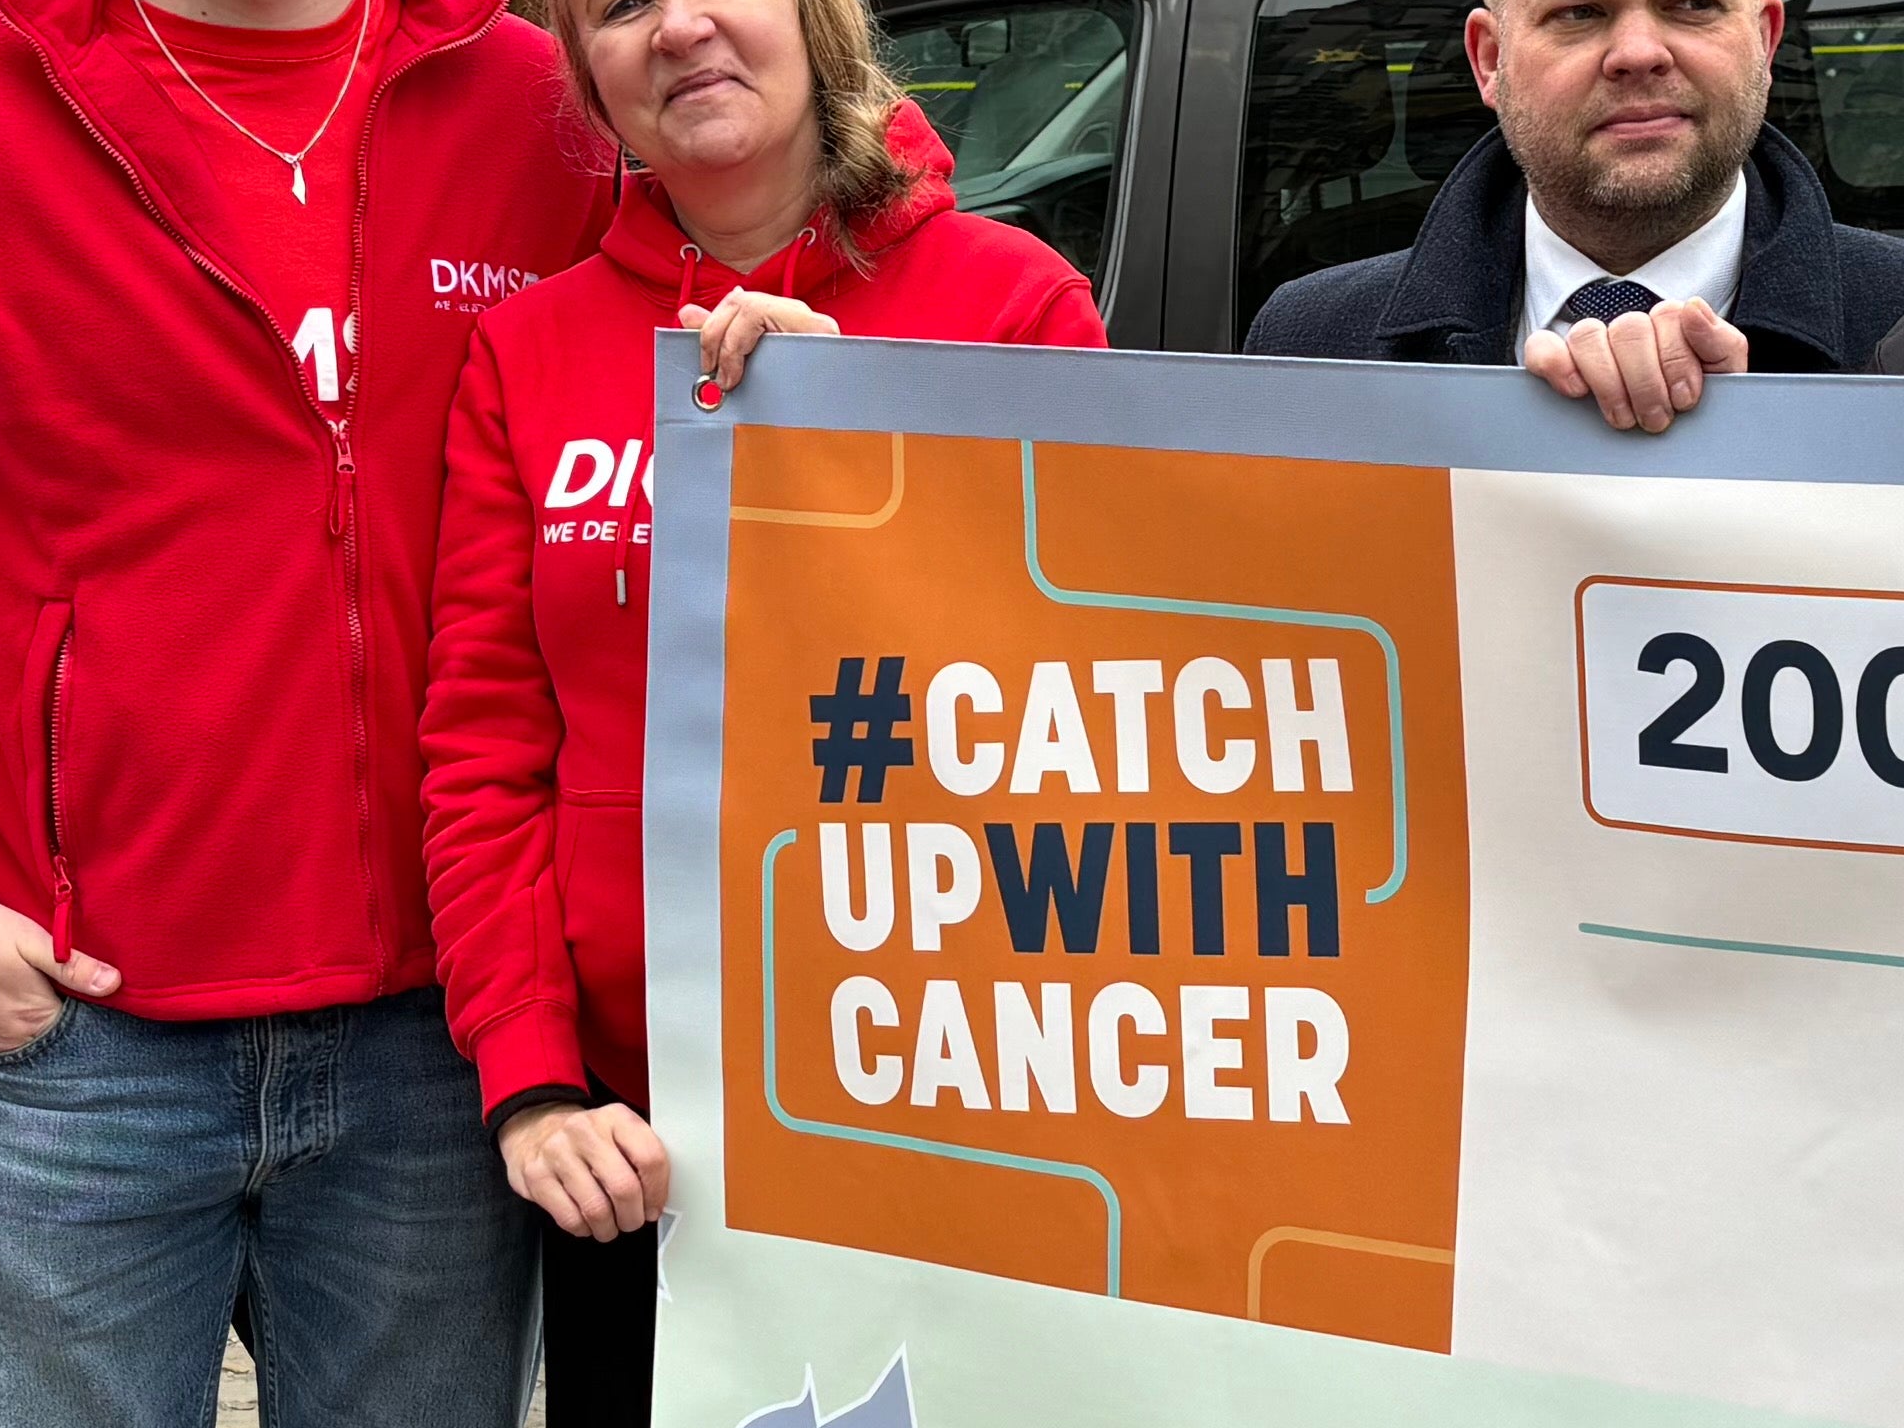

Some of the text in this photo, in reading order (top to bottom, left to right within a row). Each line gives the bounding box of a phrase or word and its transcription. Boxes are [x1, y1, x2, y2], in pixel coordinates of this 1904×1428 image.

[430, 258, 520, 299] DKMS
[543, 519, 652, 545] WE DEE
[809, 656, 1355, 804] #CATCH
[829, 975, 1352, 1125] CANCER
